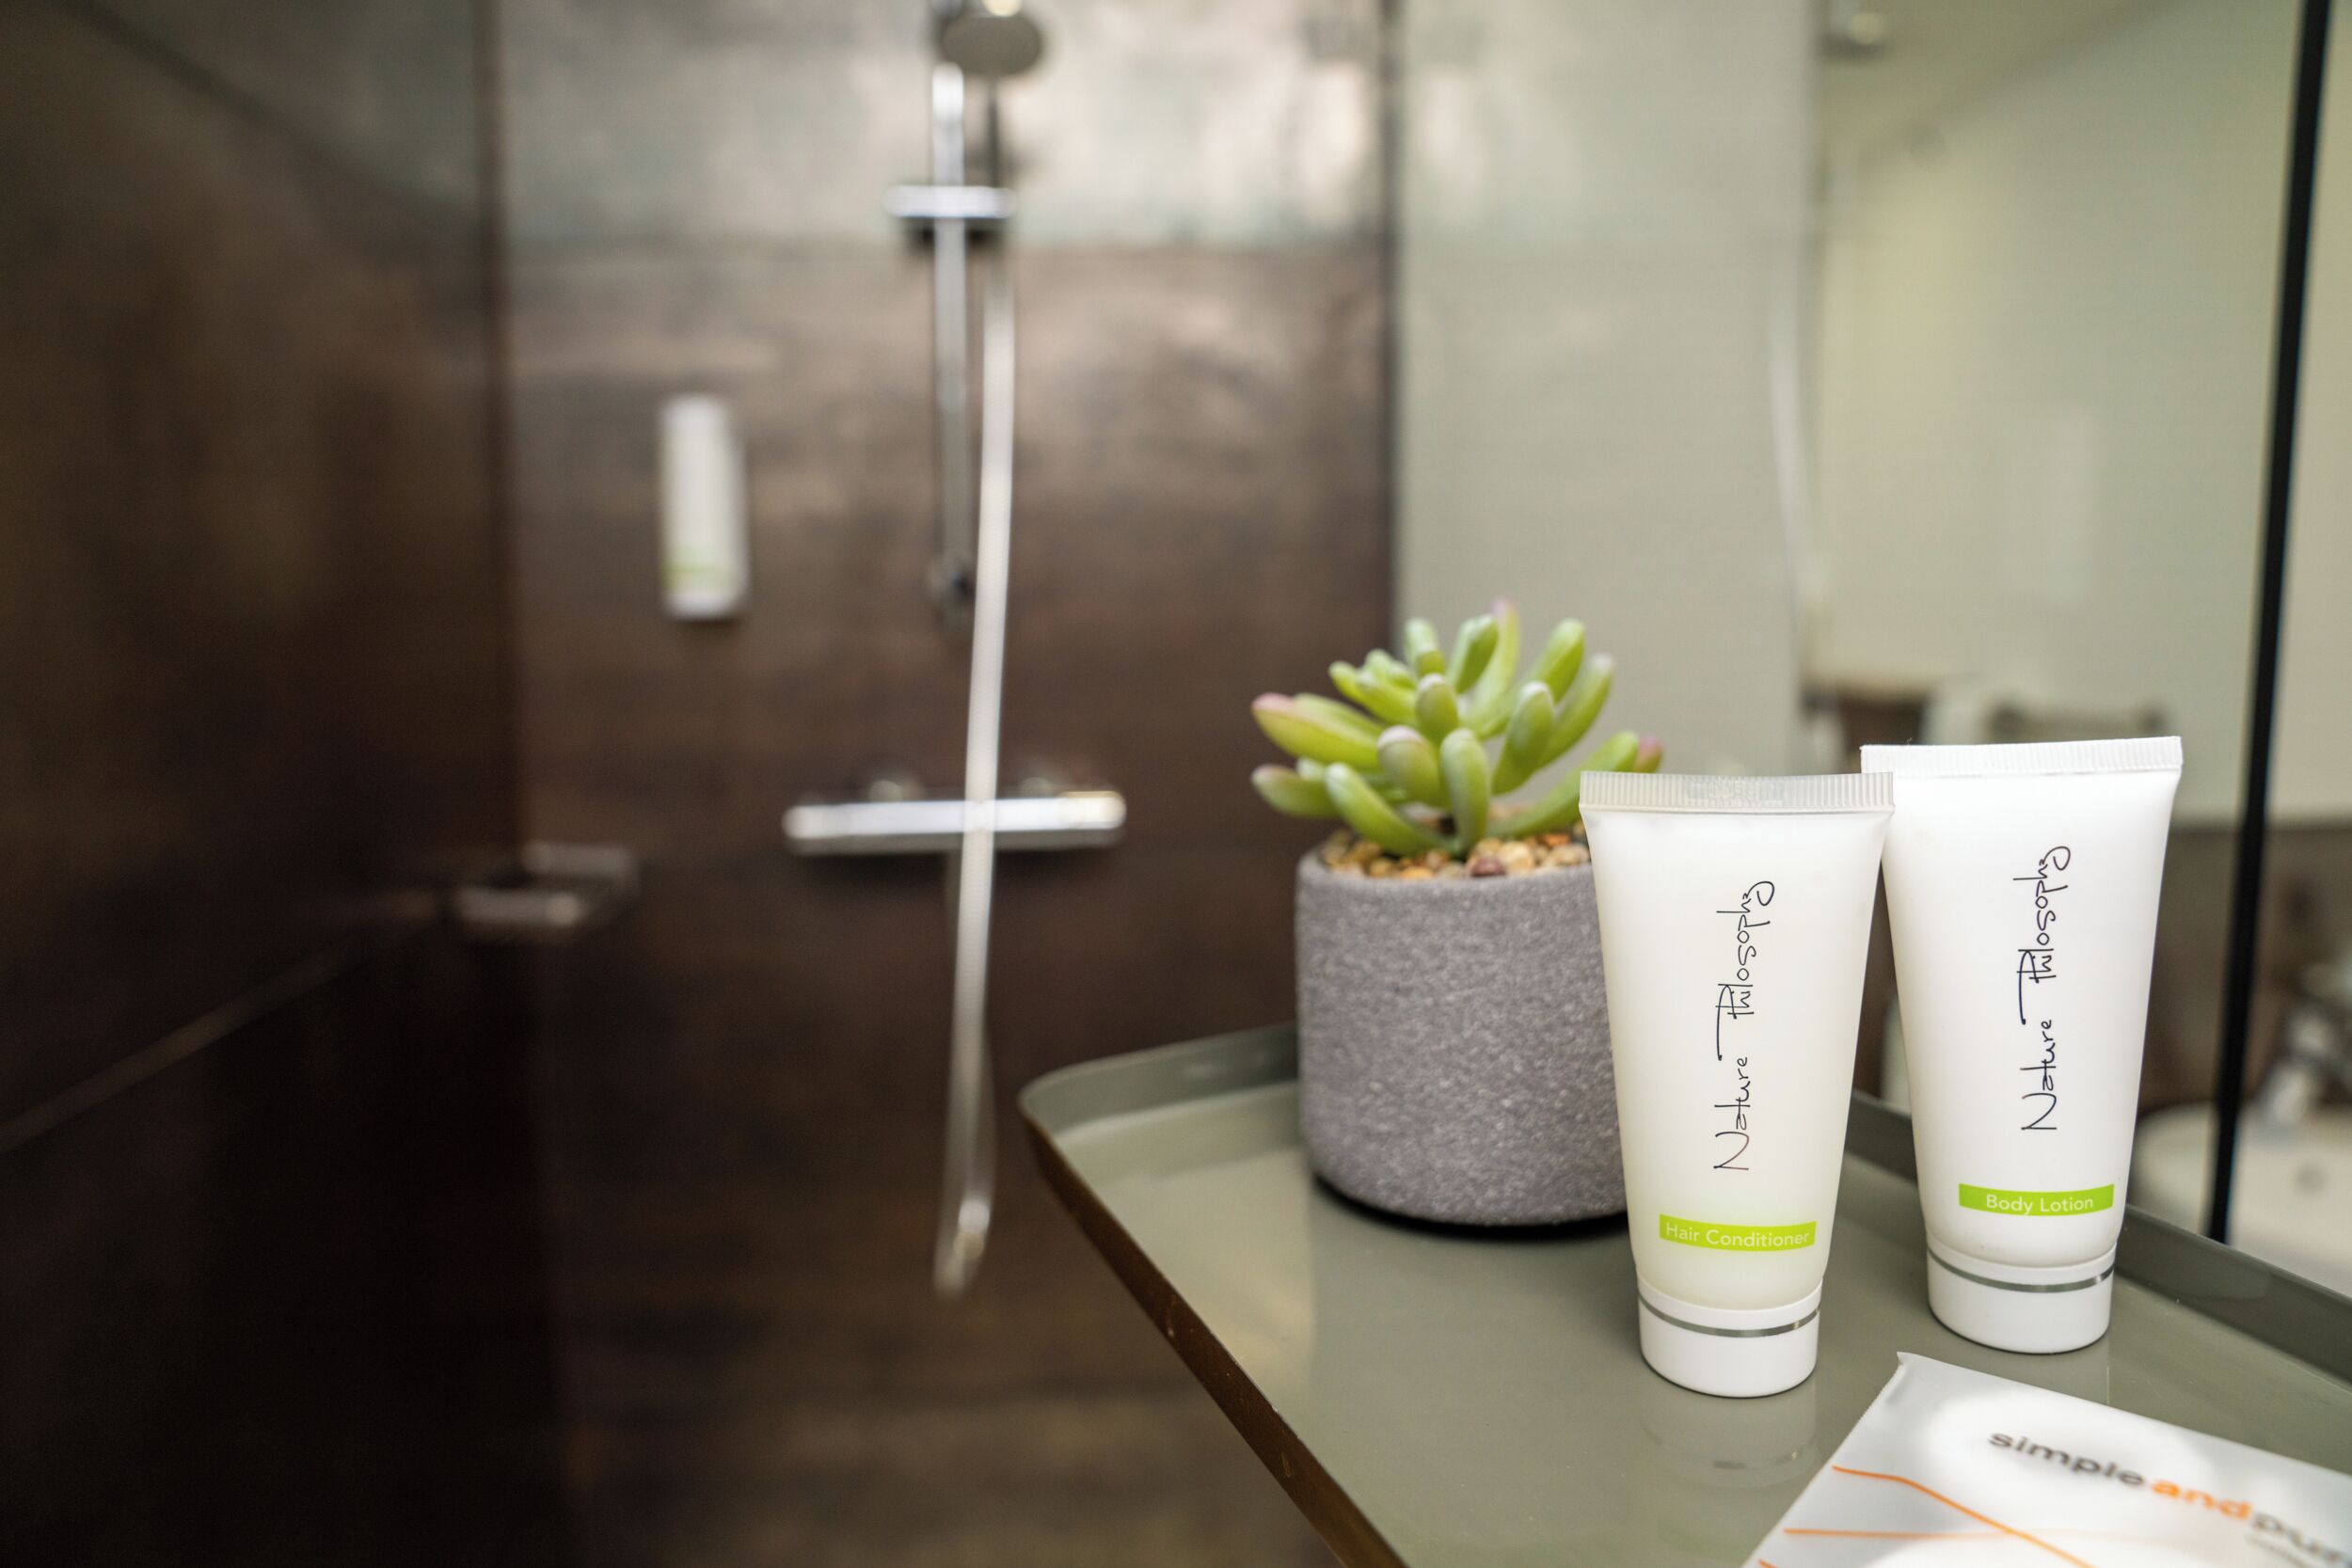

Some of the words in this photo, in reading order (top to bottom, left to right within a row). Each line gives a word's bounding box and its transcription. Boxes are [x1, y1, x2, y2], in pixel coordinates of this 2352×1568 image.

[1716, 881, 1775, 1060] Philosophy
[2013, 846, 2072, 1025] Philosophy
[1713, 1056, 1751, 1171] Nature
[2019, 1019, 2058, 1131] Nature
[1665, 1222, 1700, 1242] Hair
[1706, 1228, 1809, 1248] Conditioner
[1986, 1194, 2033, 1215] Body
[2040, 1197, 2093, 1212] Lotion
